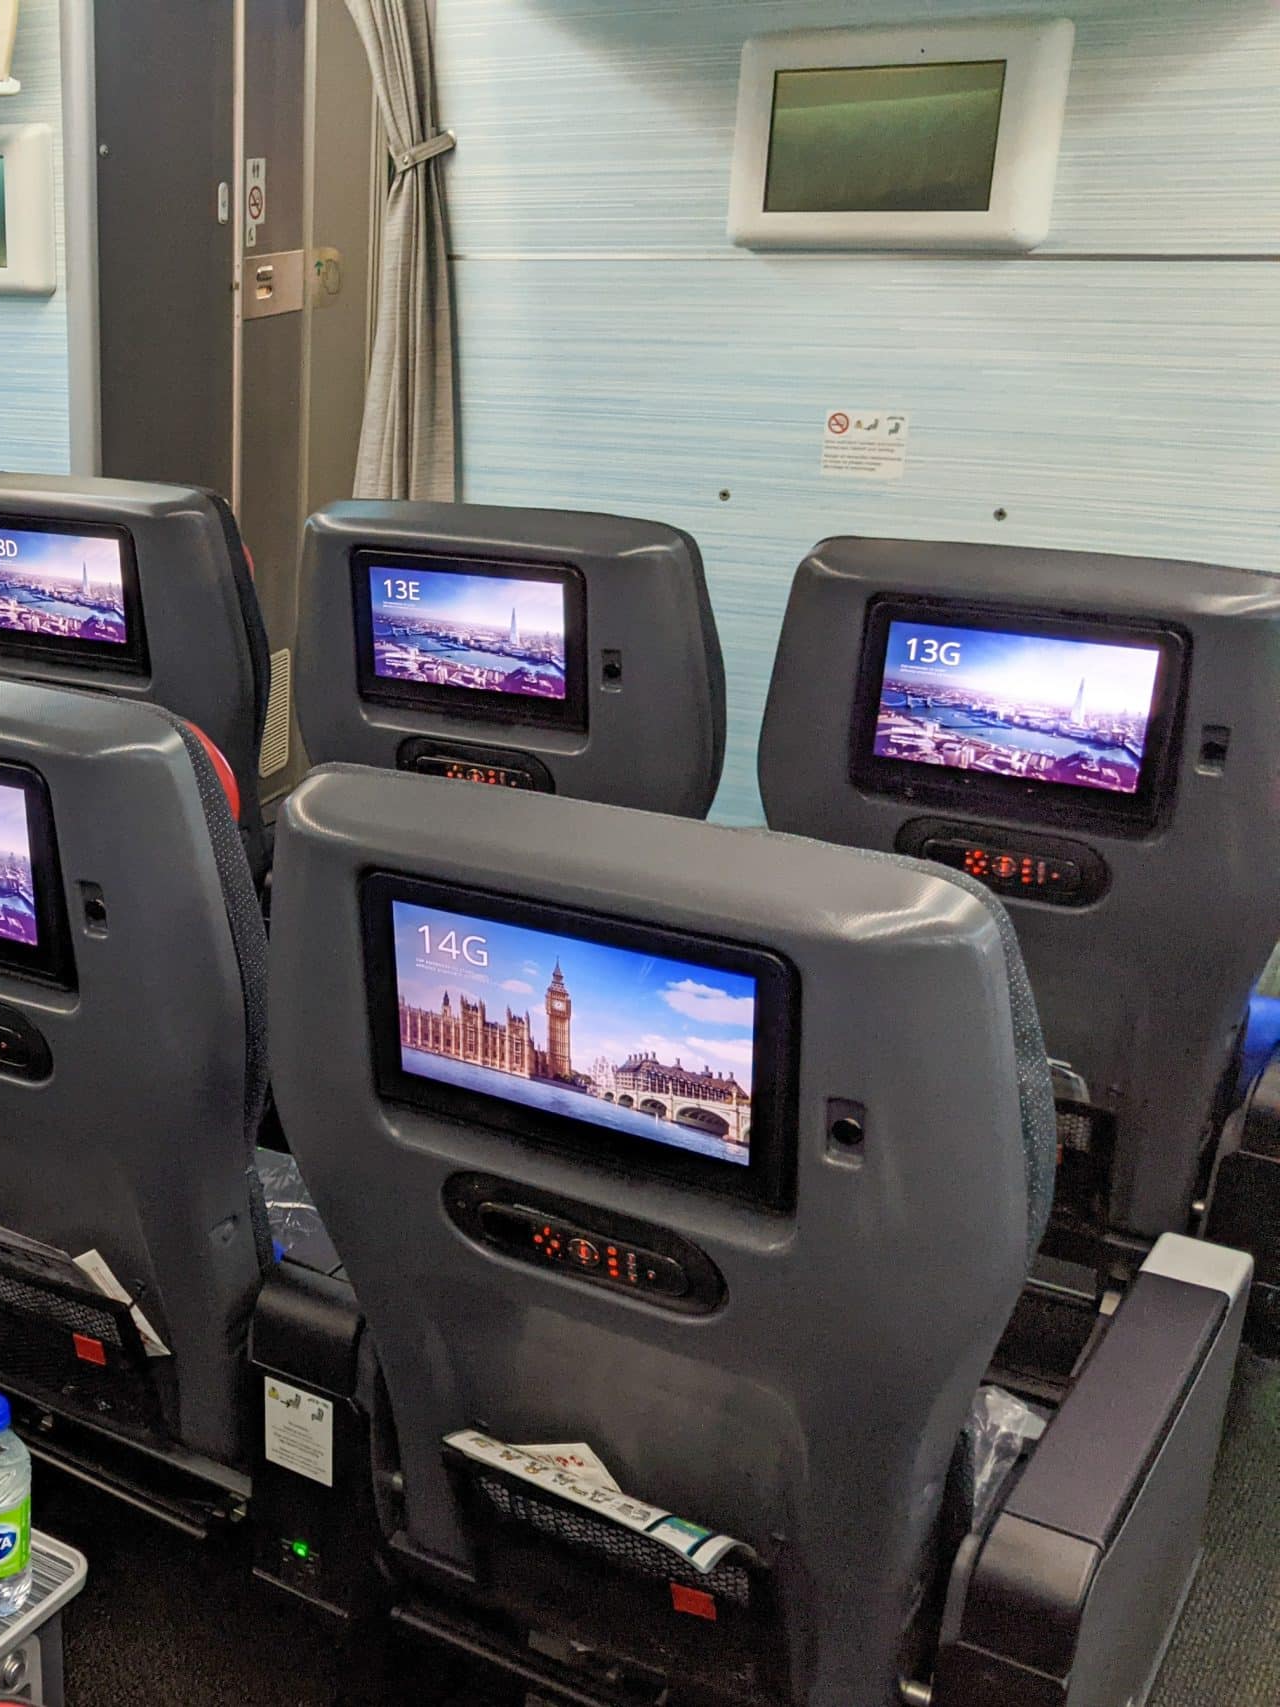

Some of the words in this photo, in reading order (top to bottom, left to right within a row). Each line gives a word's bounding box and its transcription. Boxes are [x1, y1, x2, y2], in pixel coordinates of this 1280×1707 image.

[383, 579, 420, 600] 13E
[906, 638, 961, 666] 13G
[418, 924, 488, 967] 14G
